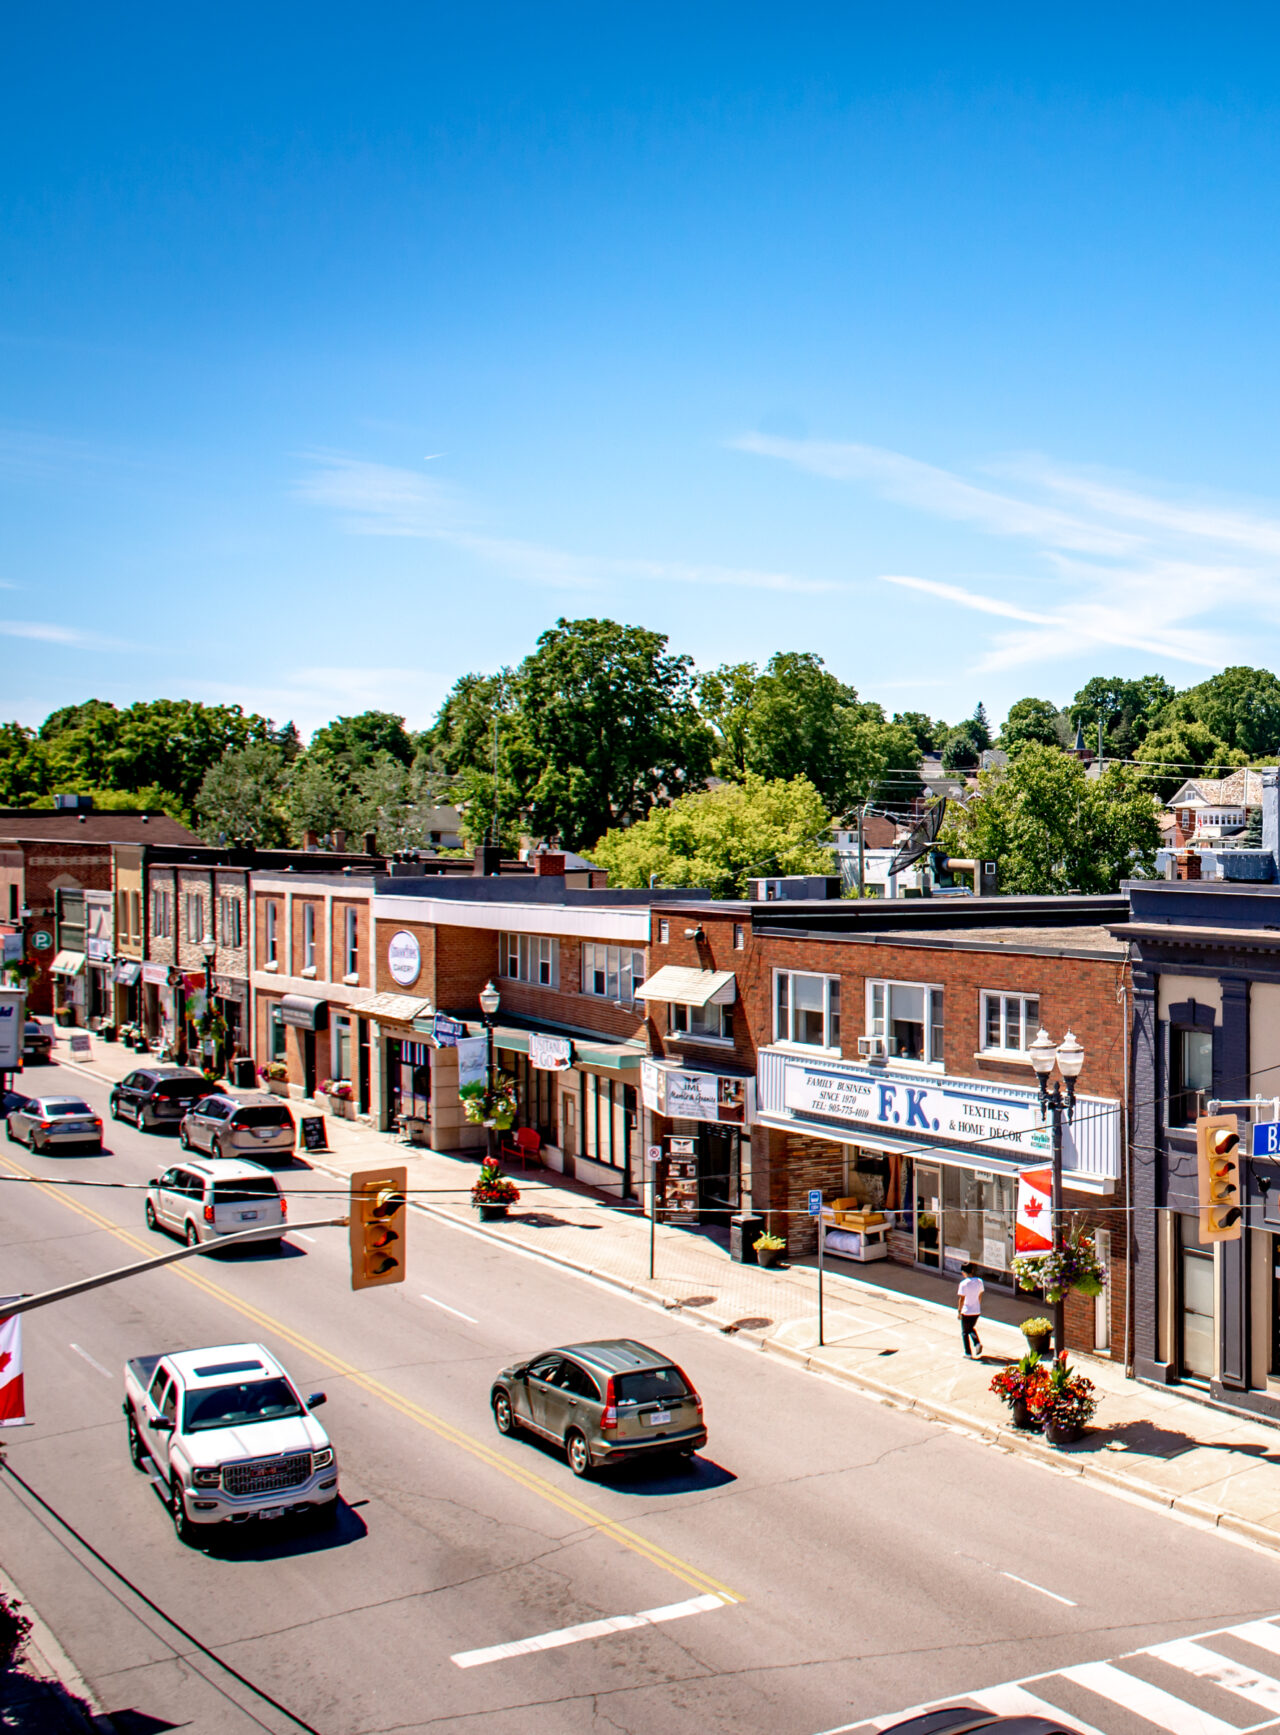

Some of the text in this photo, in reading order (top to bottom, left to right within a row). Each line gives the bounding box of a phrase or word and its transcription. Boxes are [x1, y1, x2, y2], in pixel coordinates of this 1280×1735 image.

[807, 1077, 872, 1095] FAMILY BUSINESS
[819, 1091, 857, 1105] SINCE 1970
[812, 1100, 869, 1118] TEL: 905-775-4010
[877, 1084, 940, 1131] F.K.
[963, 1104, 1010, 1122] TEXTILES
[949, 1120, 1022, 1142] & HOME DECOR
